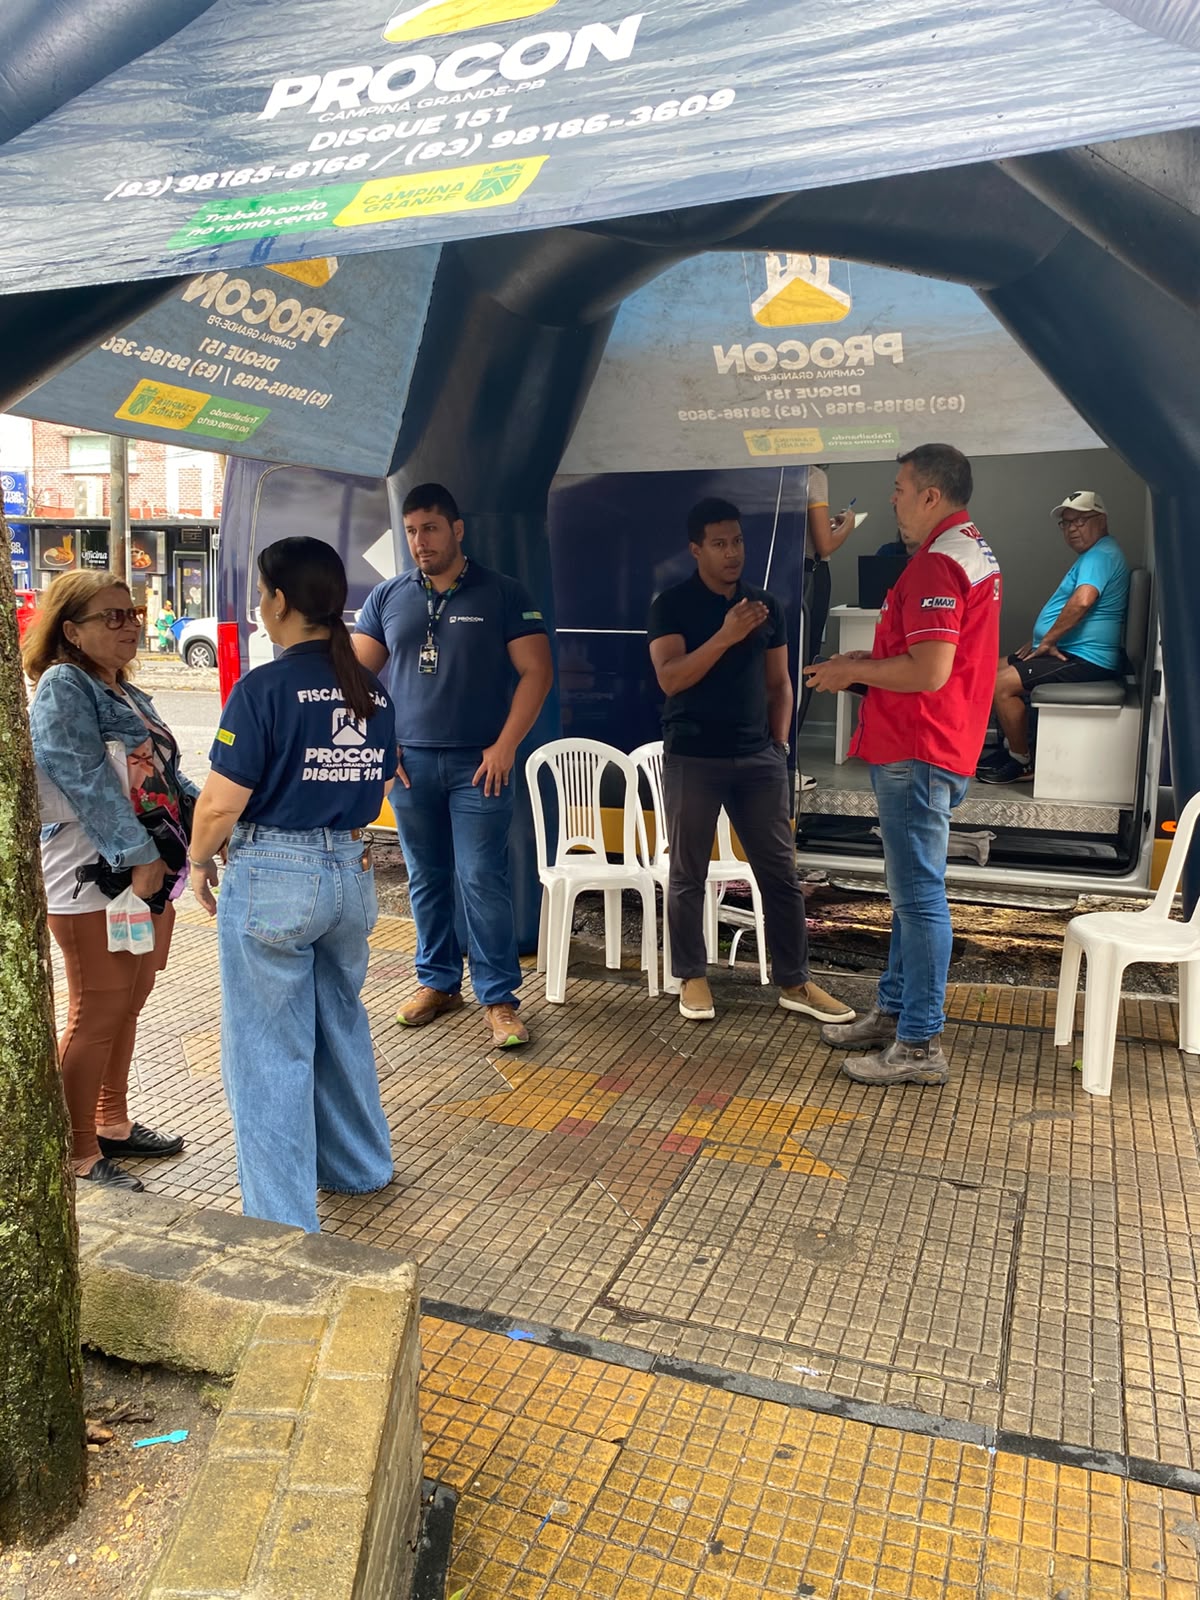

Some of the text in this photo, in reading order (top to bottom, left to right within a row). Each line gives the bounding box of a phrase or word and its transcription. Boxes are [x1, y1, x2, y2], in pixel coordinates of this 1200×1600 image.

[257, 12, 645, 121] PROCON
[318, 78, 546, 123] CAMPINA GRANDE-PB
[173, 153, 371, 194] 98185-8168
[368, 145, 405, 171] /
[404, 133, 484, 167] (83)
[488, 88, 737, 150] 98186-3609
[307, 104, 513, 153] DISQUE 151
[202, 199, 328, 225] Trabalhando
[363, 181, 466, 214] CAMPINA GRANDE
[185, 210, 329, 238] no rumo certo
[297, 687, 388, 708] FISCALÃO
[304, 747, 385, 763] PROCON
[302, 766, 383, 782] DISQUE 151
